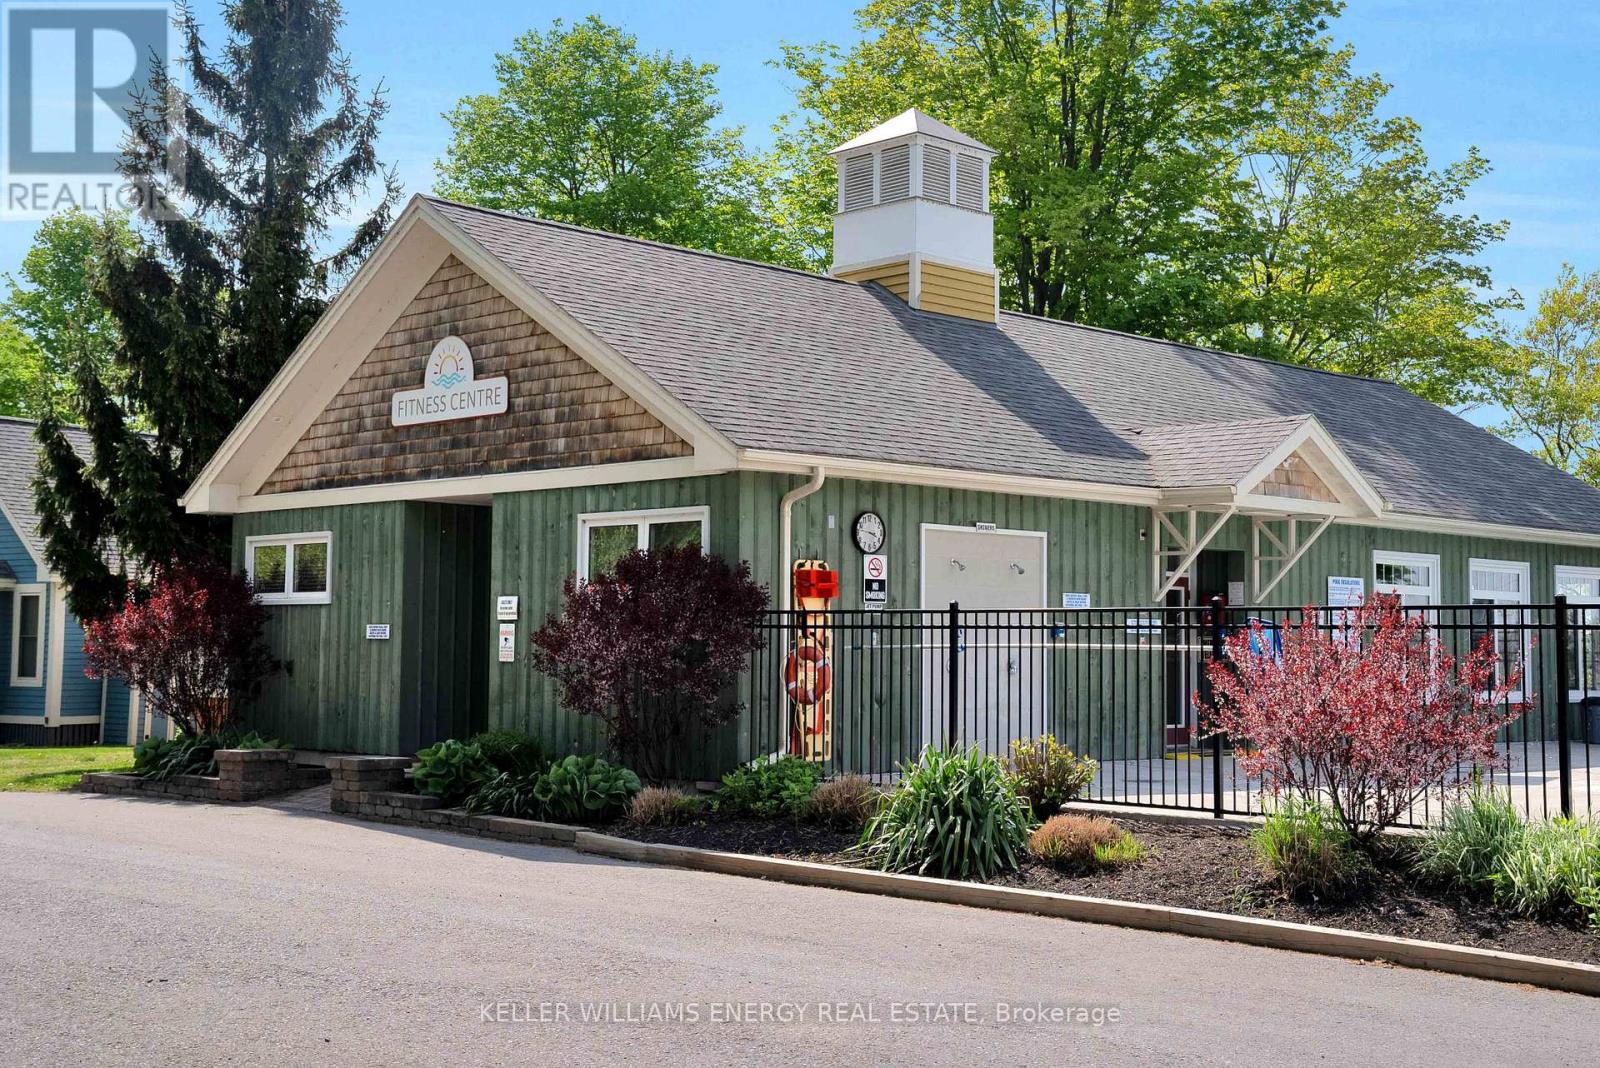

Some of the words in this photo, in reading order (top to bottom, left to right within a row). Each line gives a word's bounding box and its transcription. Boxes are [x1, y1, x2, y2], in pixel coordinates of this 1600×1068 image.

[397, 394, 447, 418] FITNESS
[450, 386, 502, 411] CENTRE
[872, 582, 879, 590] NO
[865, 591, 886, 600] SMOKING
